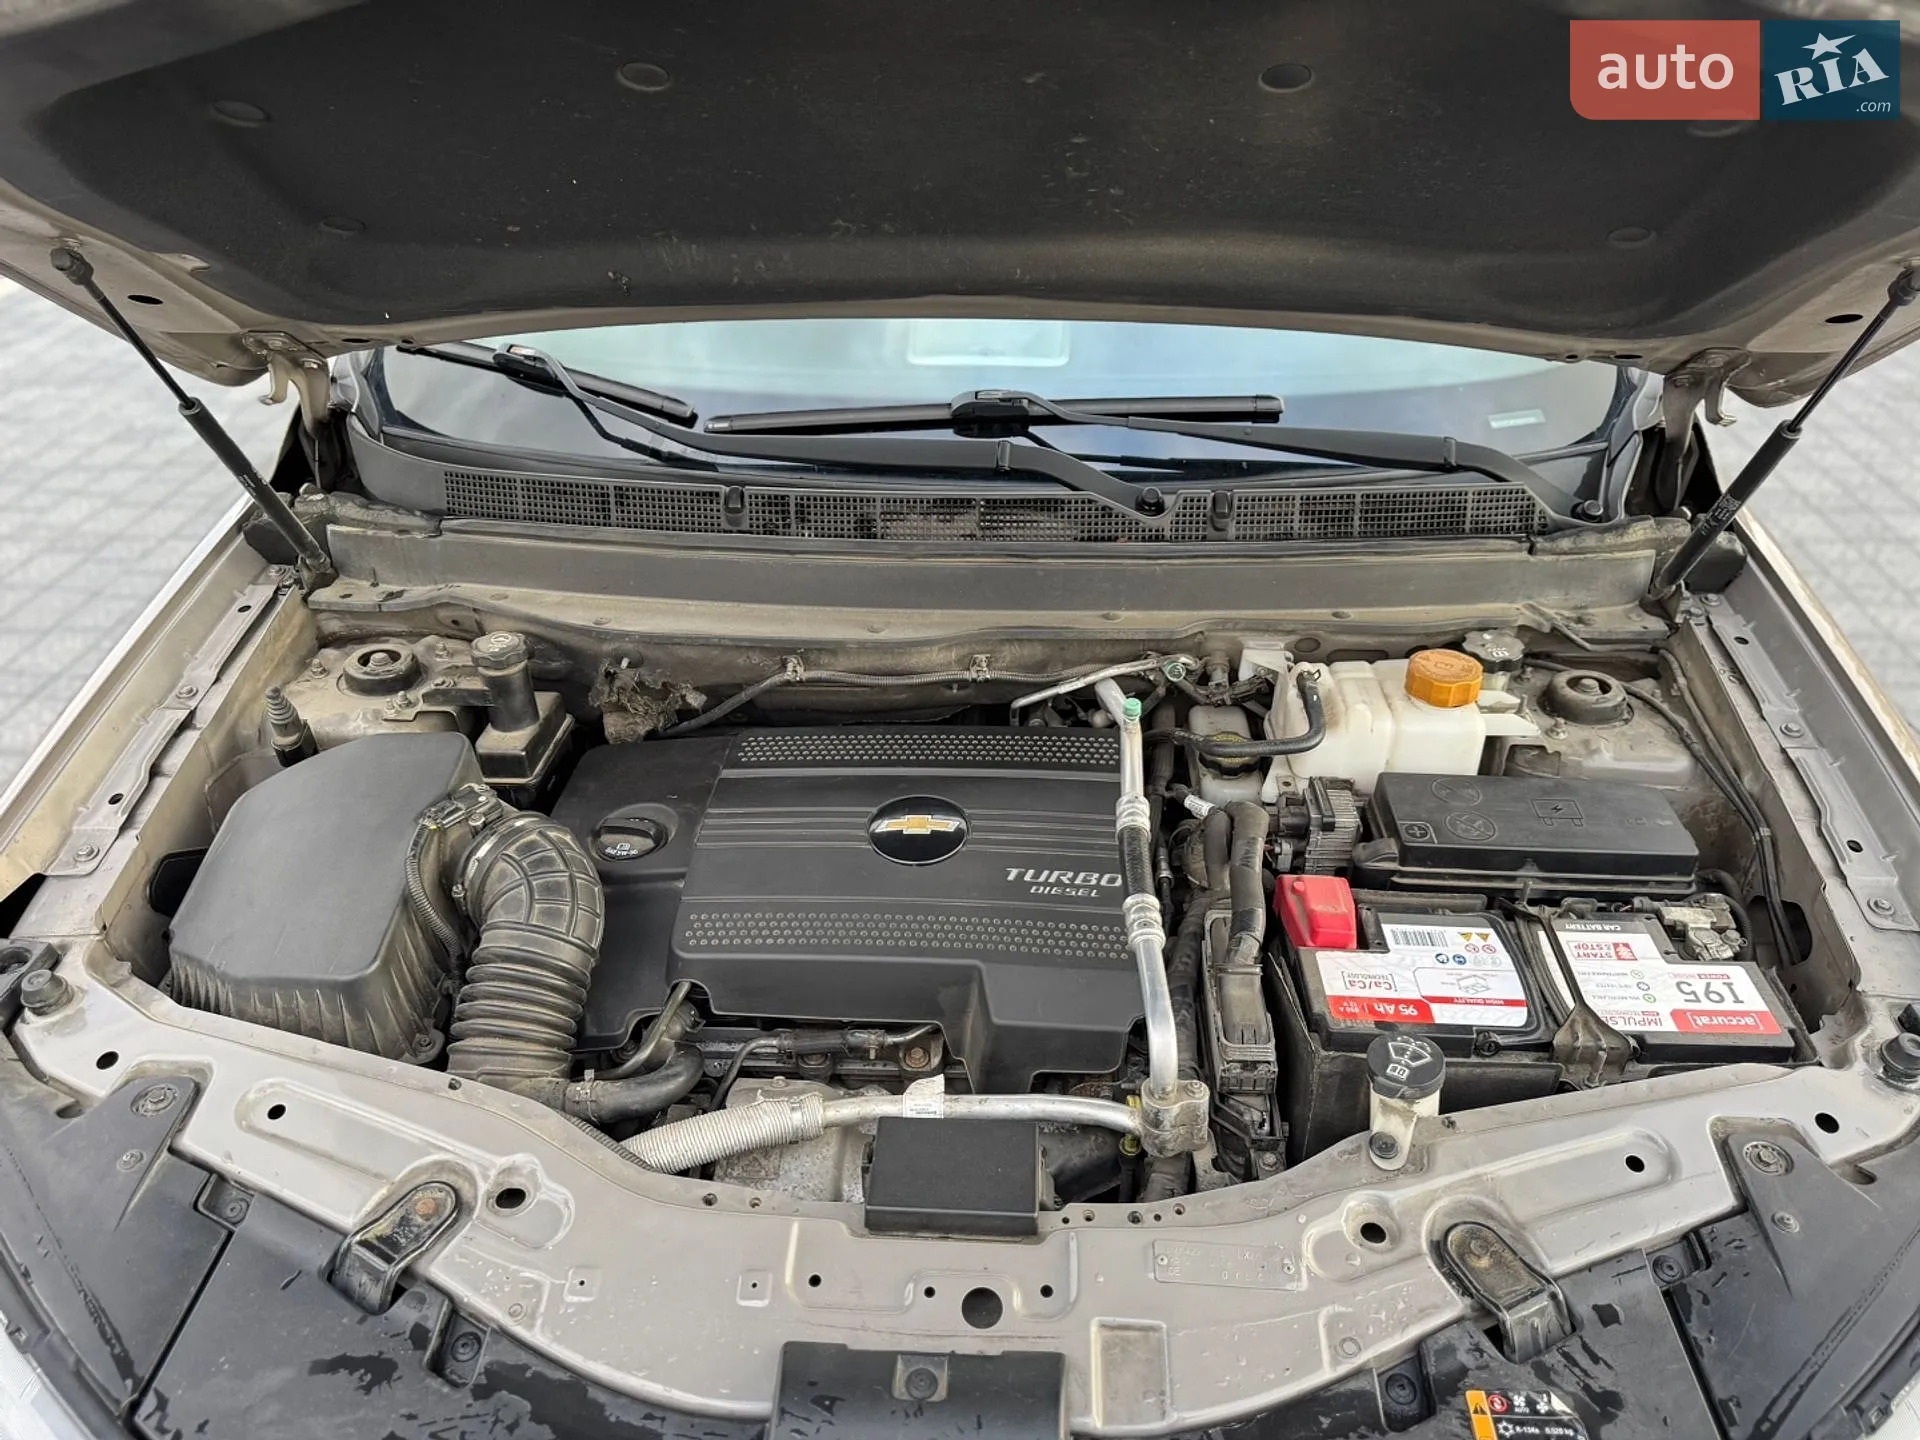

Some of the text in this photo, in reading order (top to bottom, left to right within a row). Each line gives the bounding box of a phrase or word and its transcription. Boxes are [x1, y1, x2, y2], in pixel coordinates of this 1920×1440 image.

[1005, 867, 1123, 887] TURBO
[1029, 885, 1100, 898] DIESEL
[1565, 923, 1605, 931] BATTERY
[1576, 951, 1612, 959] START
[1453, 997, 1484, 1005] QUALITY
[1373, 1002, 1419, 1016] 95 Ah
